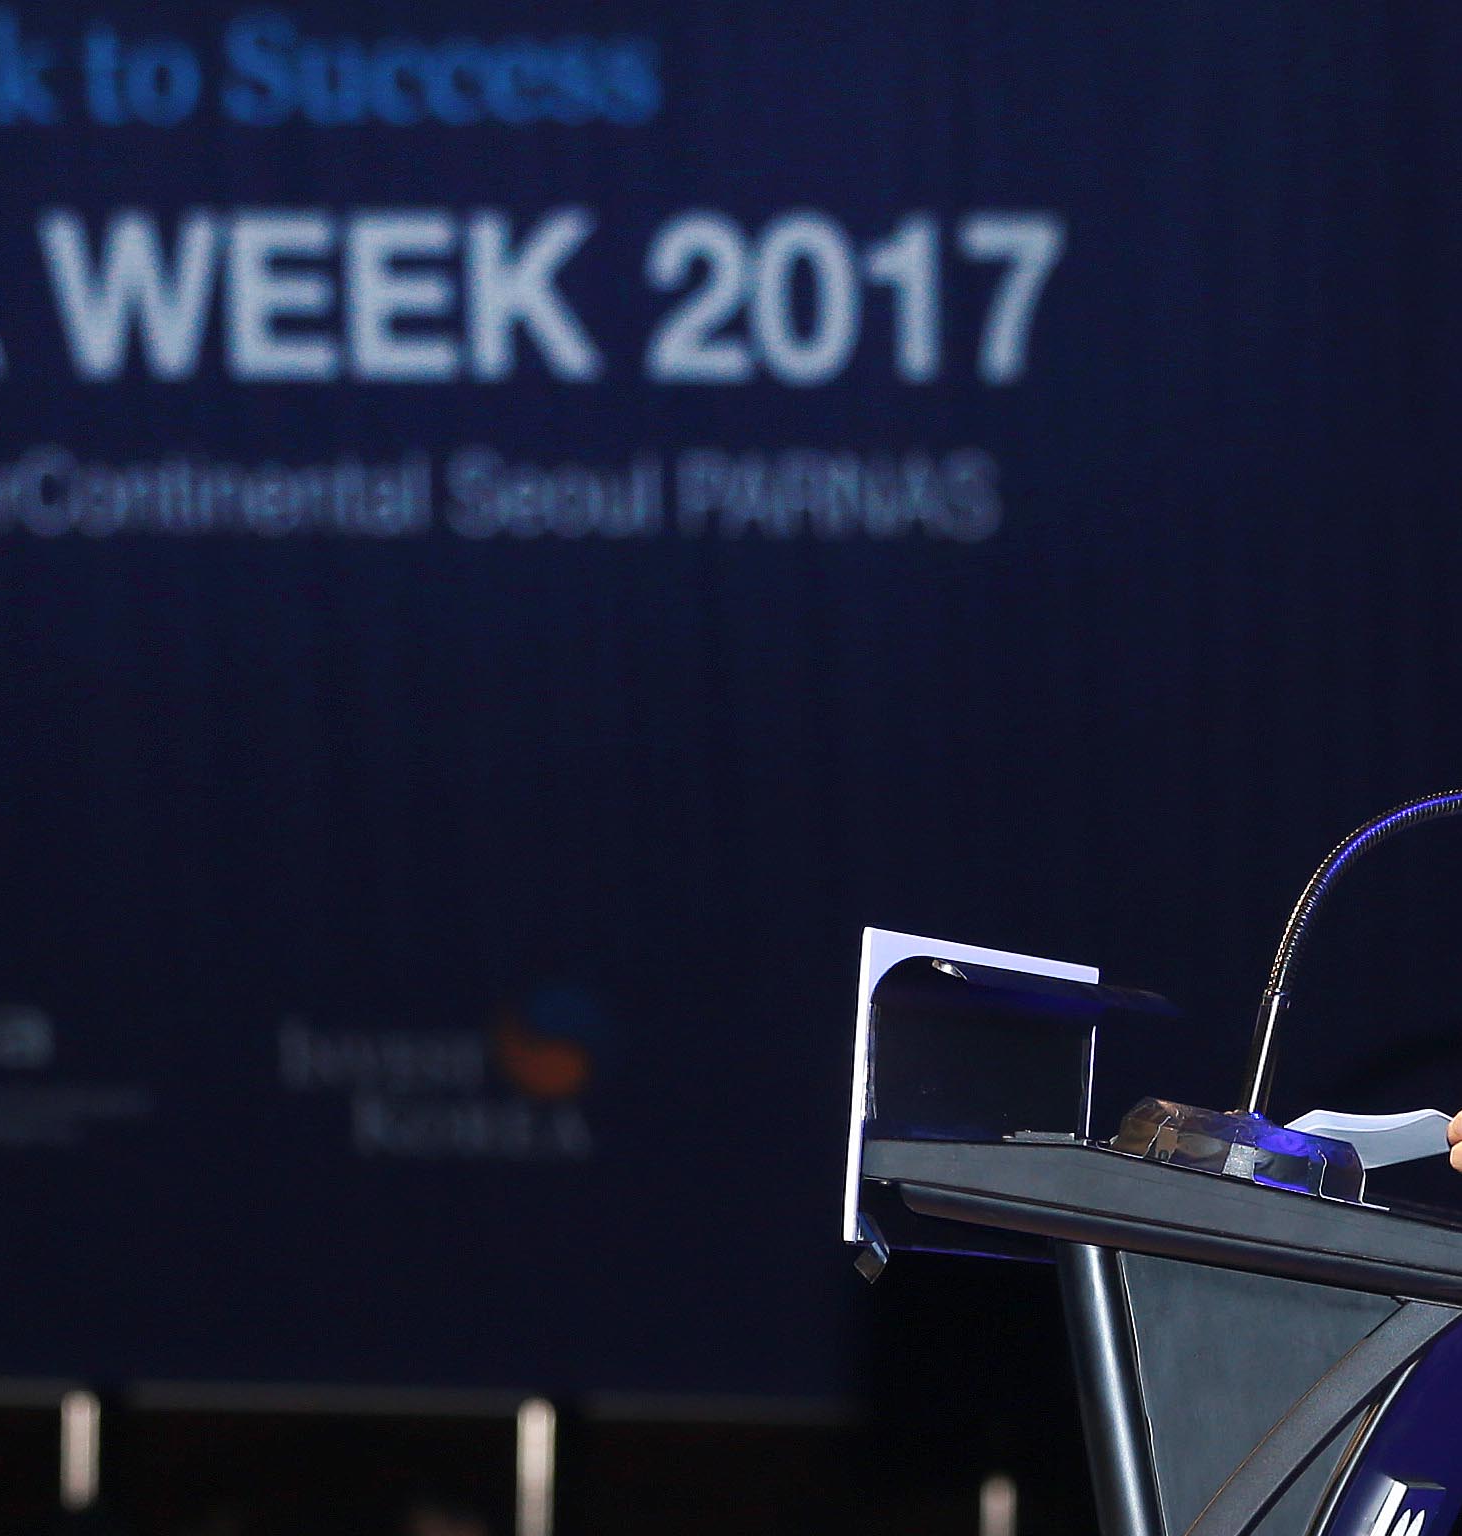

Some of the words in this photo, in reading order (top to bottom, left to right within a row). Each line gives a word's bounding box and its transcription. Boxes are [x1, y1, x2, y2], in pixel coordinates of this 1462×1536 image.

[79, 22, 204, 127] to
[219, 11, 663, 128] Success
[37, 207, 601, 382] WEEK
[644, 209, 1063, 384] 2017
[444, 444, 662, 538] Seoul
[673, 447, 1003, 540] PARNAS
